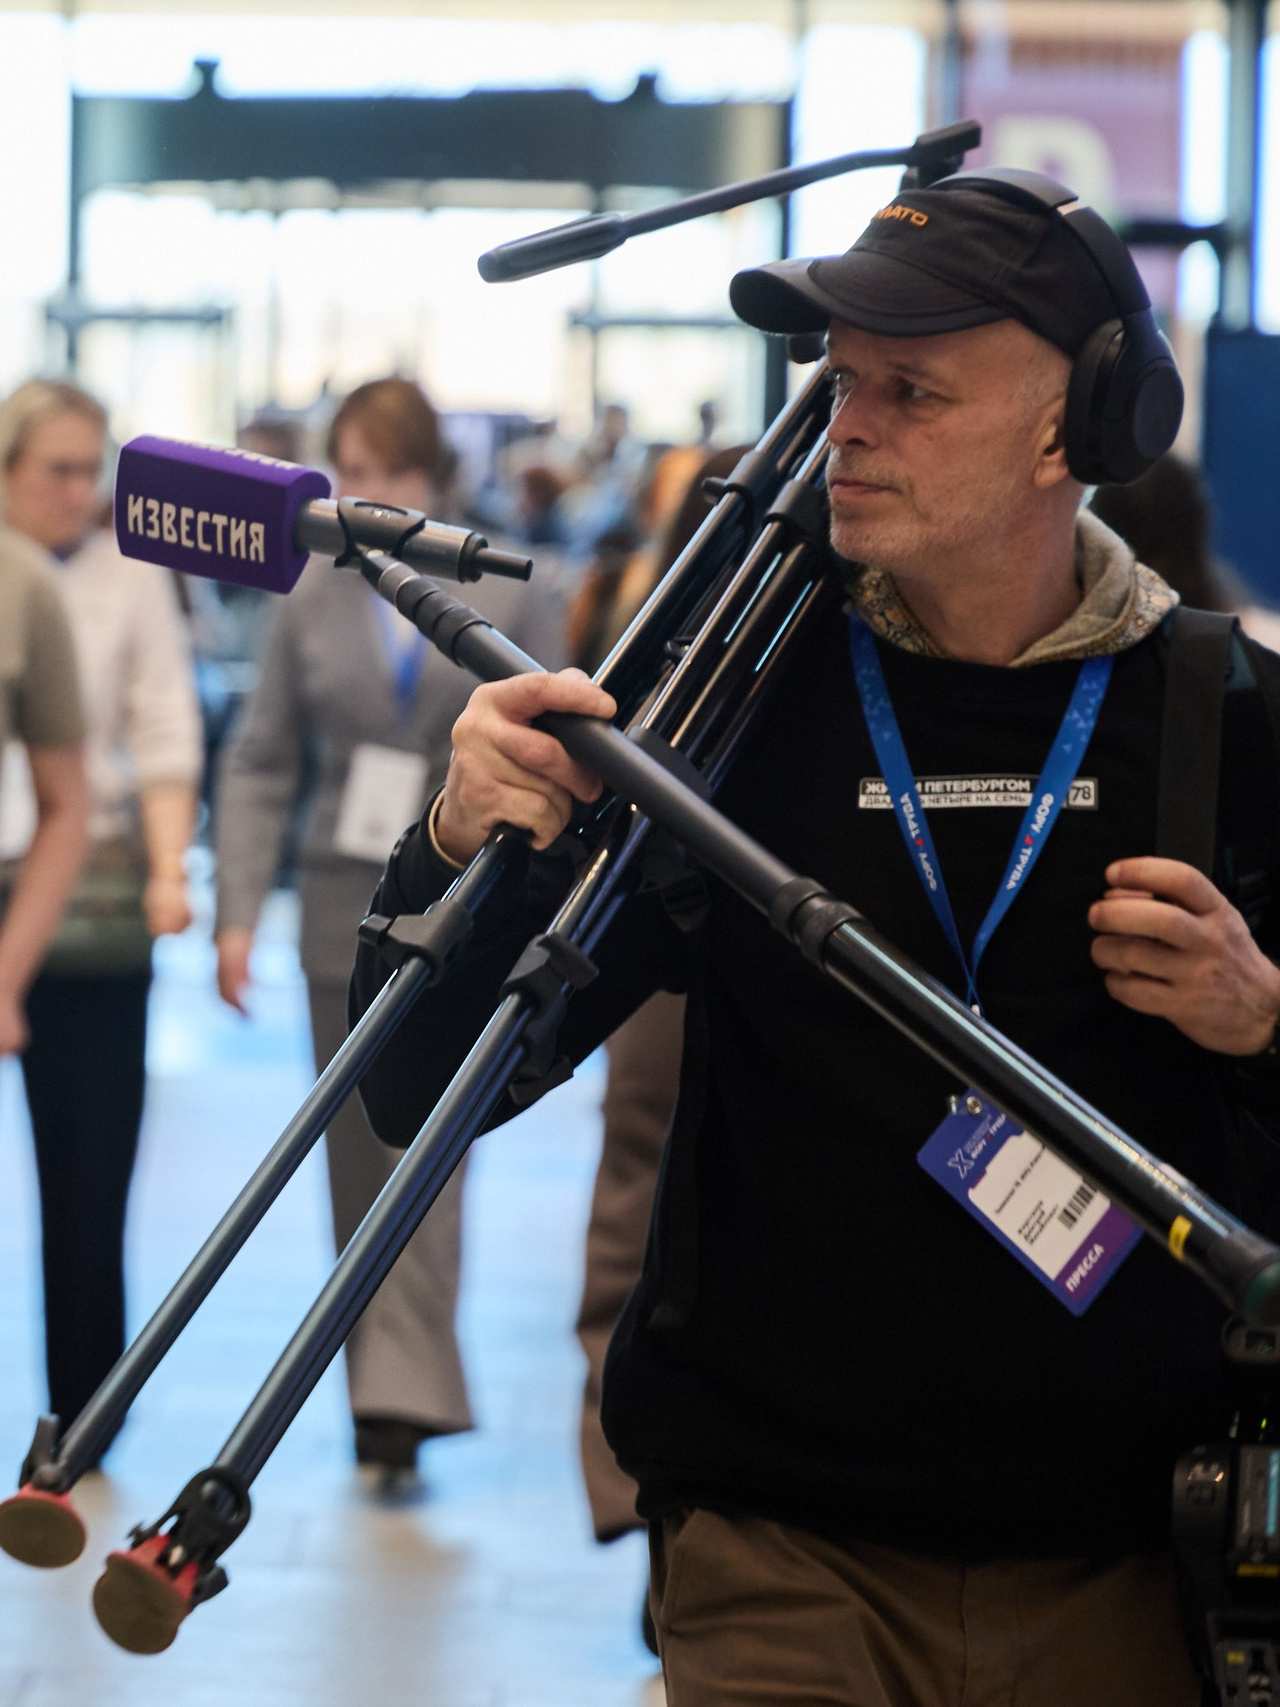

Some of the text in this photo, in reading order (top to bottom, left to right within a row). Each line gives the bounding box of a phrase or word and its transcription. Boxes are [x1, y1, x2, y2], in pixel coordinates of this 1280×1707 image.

[127, 494, 265, 564] ИЗВЕСТИЯ
[924, 779, 1030, 793] ПЕТЕРБУРГОМ
[928, 795, 971, 804] ЧЕТЫРЕ
[976, 795, 991, 803] НА
[995, 794, 1026, 802] СЕМЬ
[1071, 785, 1091, 801] 78
[900, 792, 920, 839] ТРУДА
[1006, 846, 1033, 890] ТРУДА
[1065, 1243, 1105, 1293] ПРЕССА
